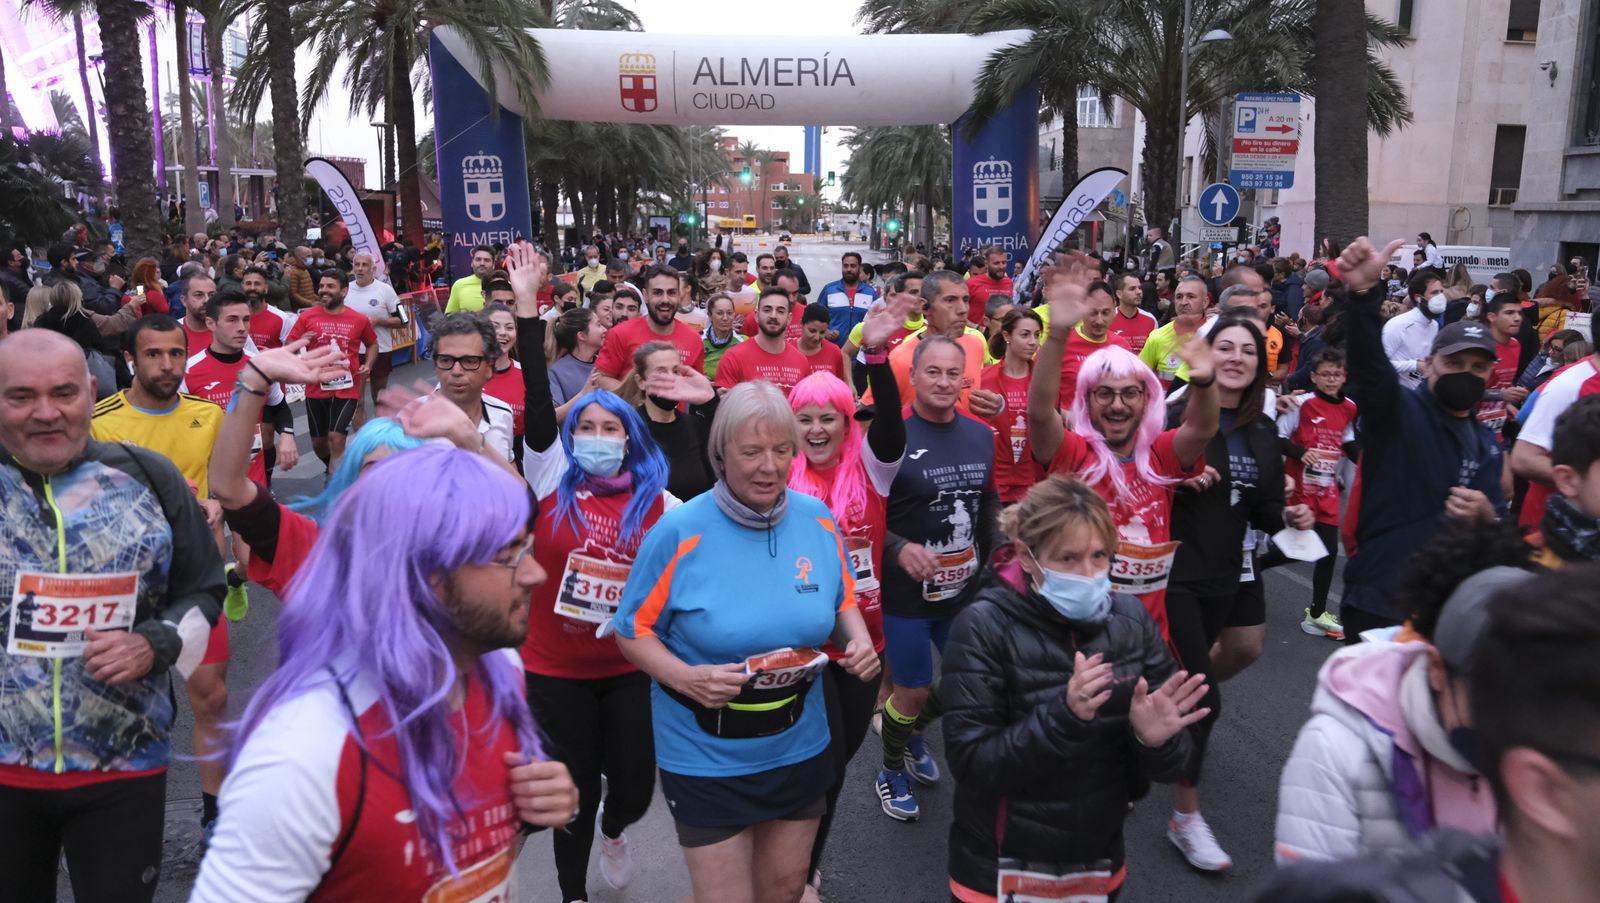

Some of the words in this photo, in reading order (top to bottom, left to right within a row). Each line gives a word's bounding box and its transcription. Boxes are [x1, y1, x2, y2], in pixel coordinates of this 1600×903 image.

[692, 52, 857, 87] ALMERÍA
[692, 93, 775, 109] CIUDAD
[1239, 108, 1255, 126] P
[929, 466, 956, 477] CARRERA
[937, 566, 971, 583] 3591
[1115, 559, 1166, 576] 3355
[37, 602, 119, 626] 3217
